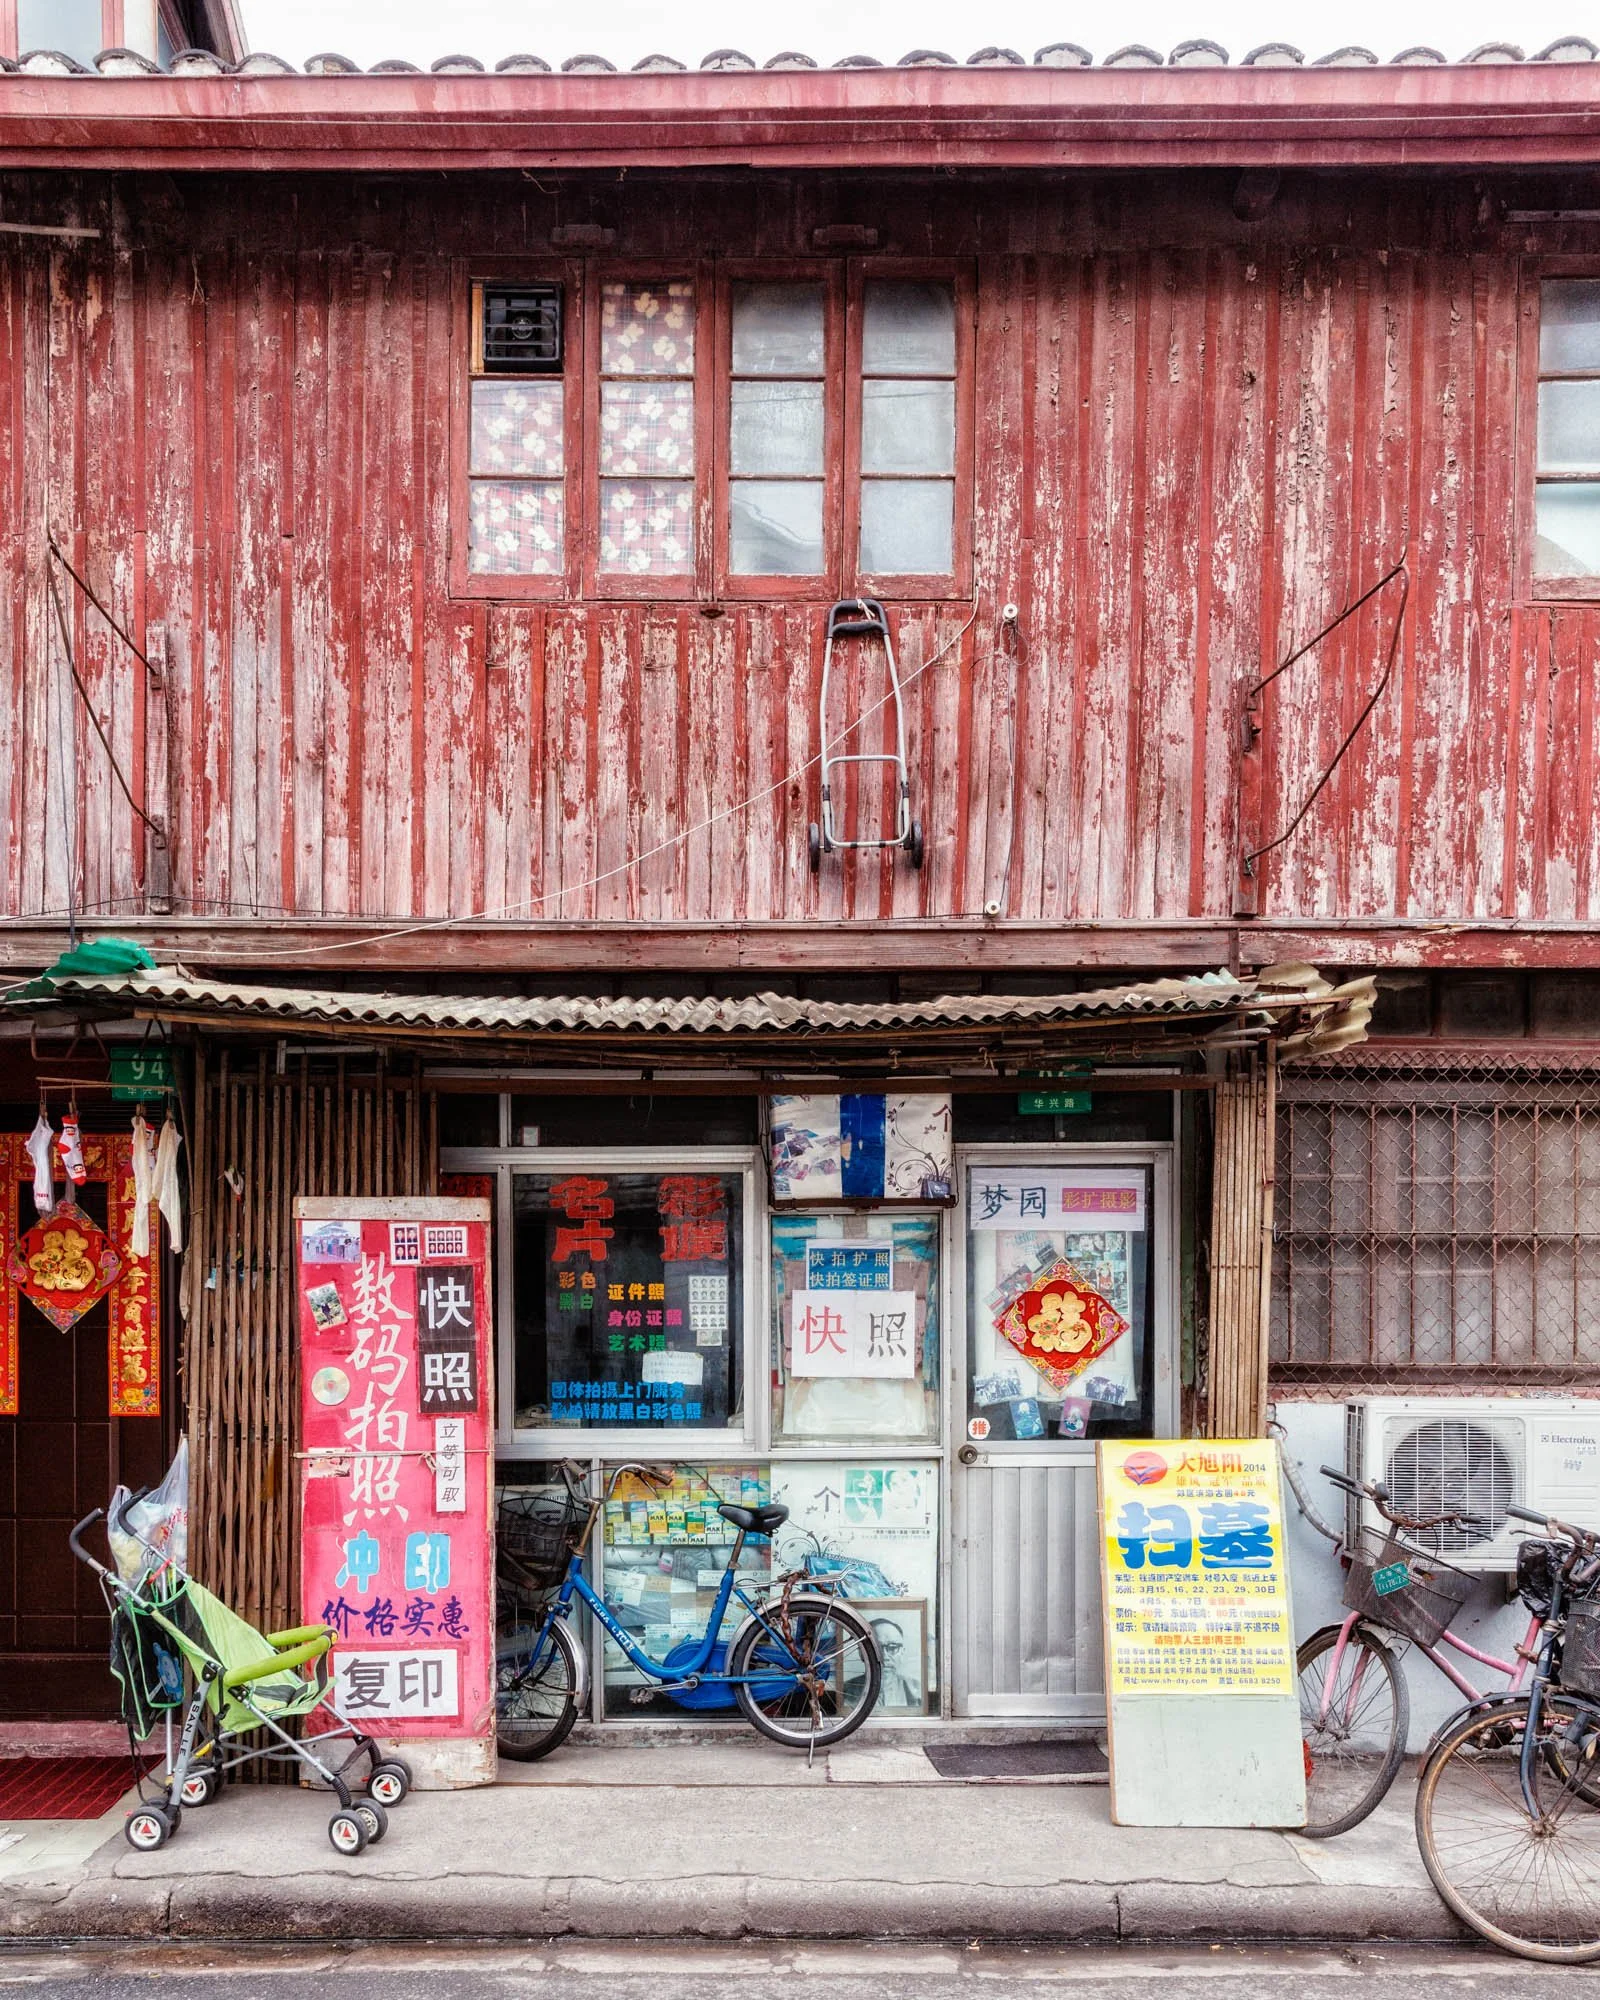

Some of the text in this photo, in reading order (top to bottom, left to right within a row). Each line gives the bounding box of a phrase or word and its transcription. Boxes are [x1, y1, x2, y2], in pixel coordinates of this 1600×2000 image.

[131, 1053, 165, 1080] 94
[1033, 1098, 1075, 1109] 华兴路
[979, 1183, 1136, 1221] 梦园 彩扩摄影
[548, 1175, 615, 1262] 名片
[809, 1251, 890, 1267] 快拍护照
[559, 1271, 597, 1289] 彩色
[607, 1283, 665, 1300] 证件照
[809, 1272, 889, 1287] 快拍签证照
[559, 1293, 594, 1311] 黑白
[607, 1309, 683, 1327] 身份证照
[798, 1305, 908, 1358] 快照
[1027, 1290, 1093, 1354] 福
[420, 1276, 474, 1403] 快照
[608, 1334, 666, 1352] 艺术照
[343, 1251, 413, 1526] 数码拍照
[551, 1381, 686, 1399] 团体拍摄上门服务
[971, 1420, 987, 1436] 推
[1551, 1434, 1596, 1445] Electrolux
[439, 1423, 461, 1503] 立等可取
[1175, 1452, 1266, 1473] 大旭阳 2014
[1116, 1501, 1274, 1570] 扫墓
[334, 1528, 451, 1595] 冲印
[322, 1596, 470, 1640] 价格实惠
[341, 1656, 444, 1710] 复印
[179, 1704, 200, 1756] SAN LE
